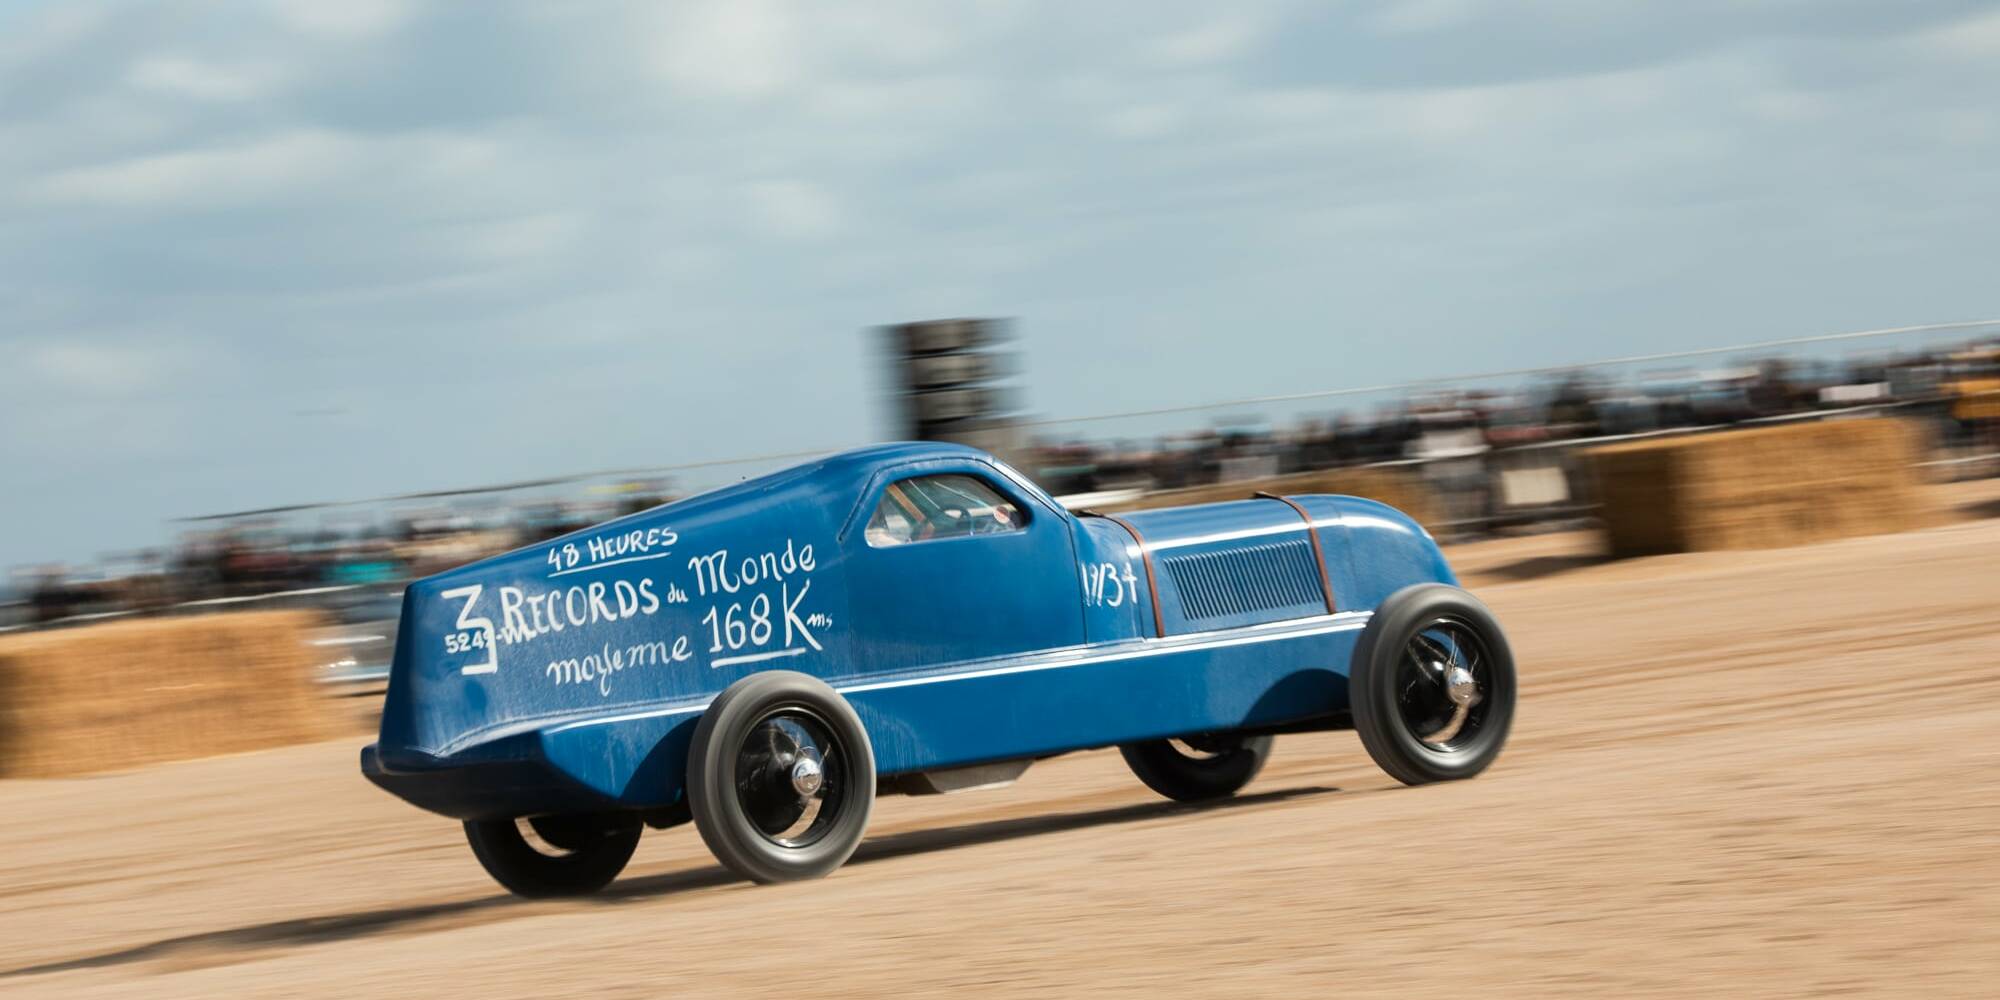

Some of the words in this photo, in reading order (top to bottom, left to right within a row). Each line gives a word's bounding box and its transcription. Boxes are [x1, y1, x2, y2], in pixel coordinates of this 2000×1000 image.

[548, 543, 580, 571] 48
[587, 526, 678, 563] HEURES
[441, 584, 498, 676] 3
[500, 578, 660, 638] RECORDS
[667, 582, 689, 604] du
[688, 538, 816, 597] Monde
[546, 634, 693, 697] moyenne
[702, 592, 772, 653] 168
